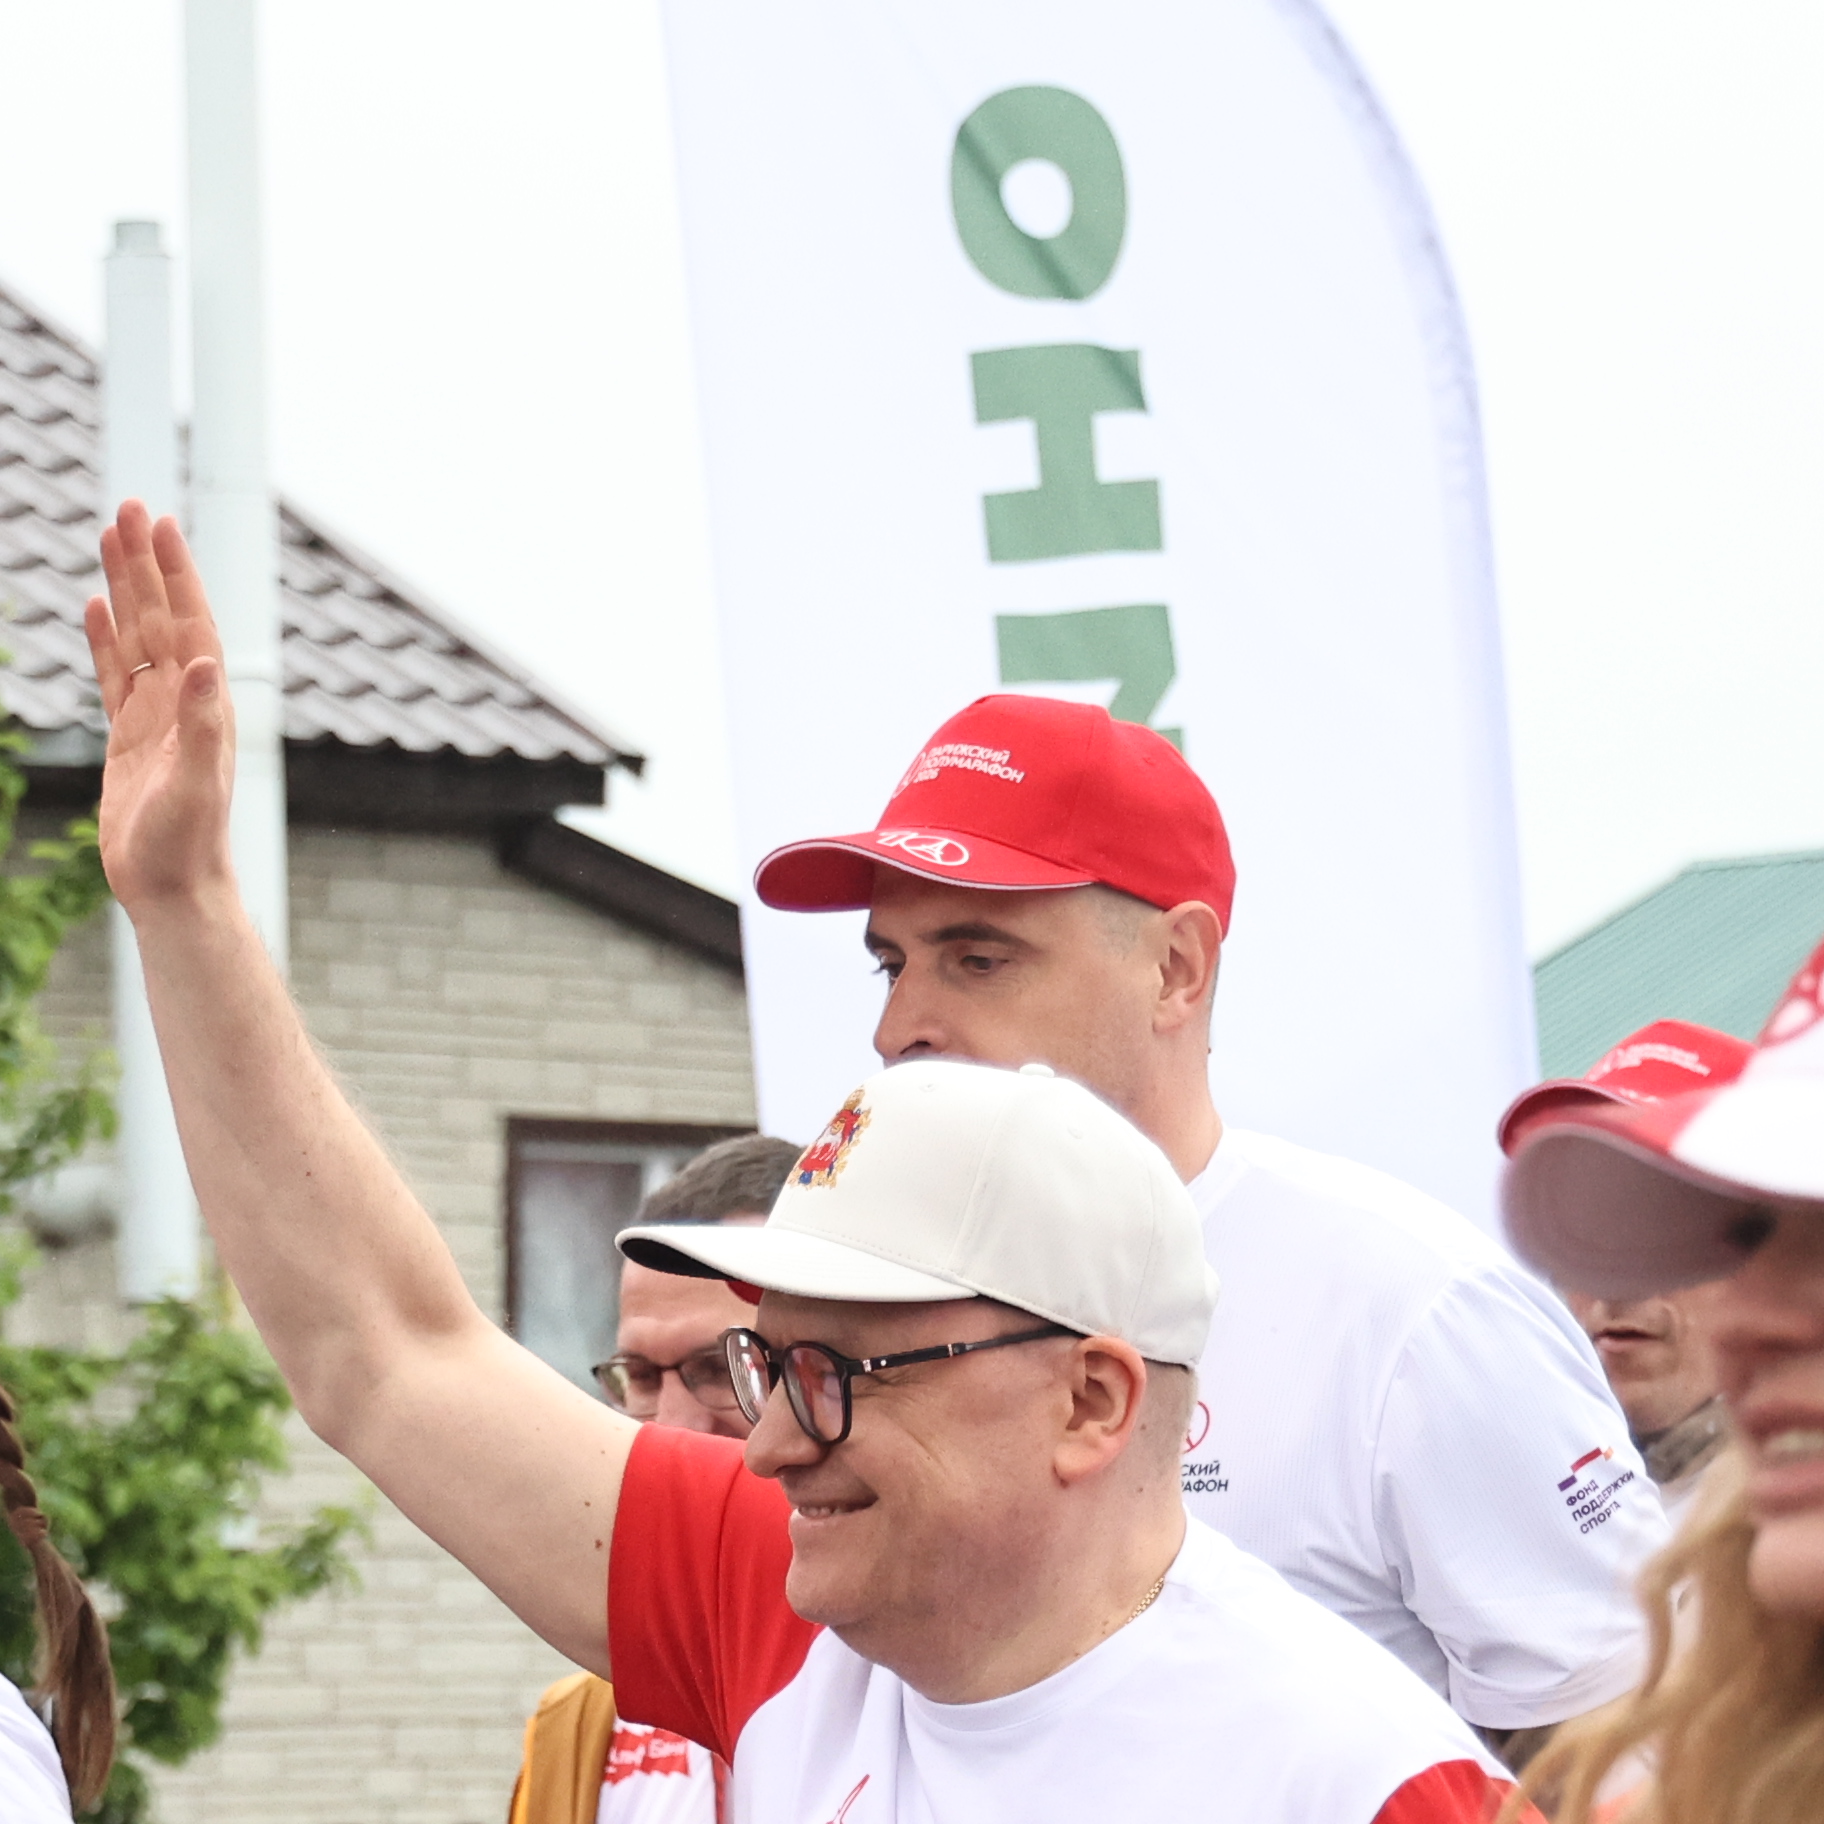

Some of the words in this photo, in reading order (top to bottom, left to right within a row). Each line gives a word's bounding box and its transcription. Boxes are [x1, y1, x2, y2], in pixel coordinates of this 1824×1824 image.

[1565, 1479, 1600, 1507] ФОНД
[1571, 1469, 1635, 1522] ПОДДЕРЖКИ
[1580, 1500, 1621, 1535] СПОРТА
